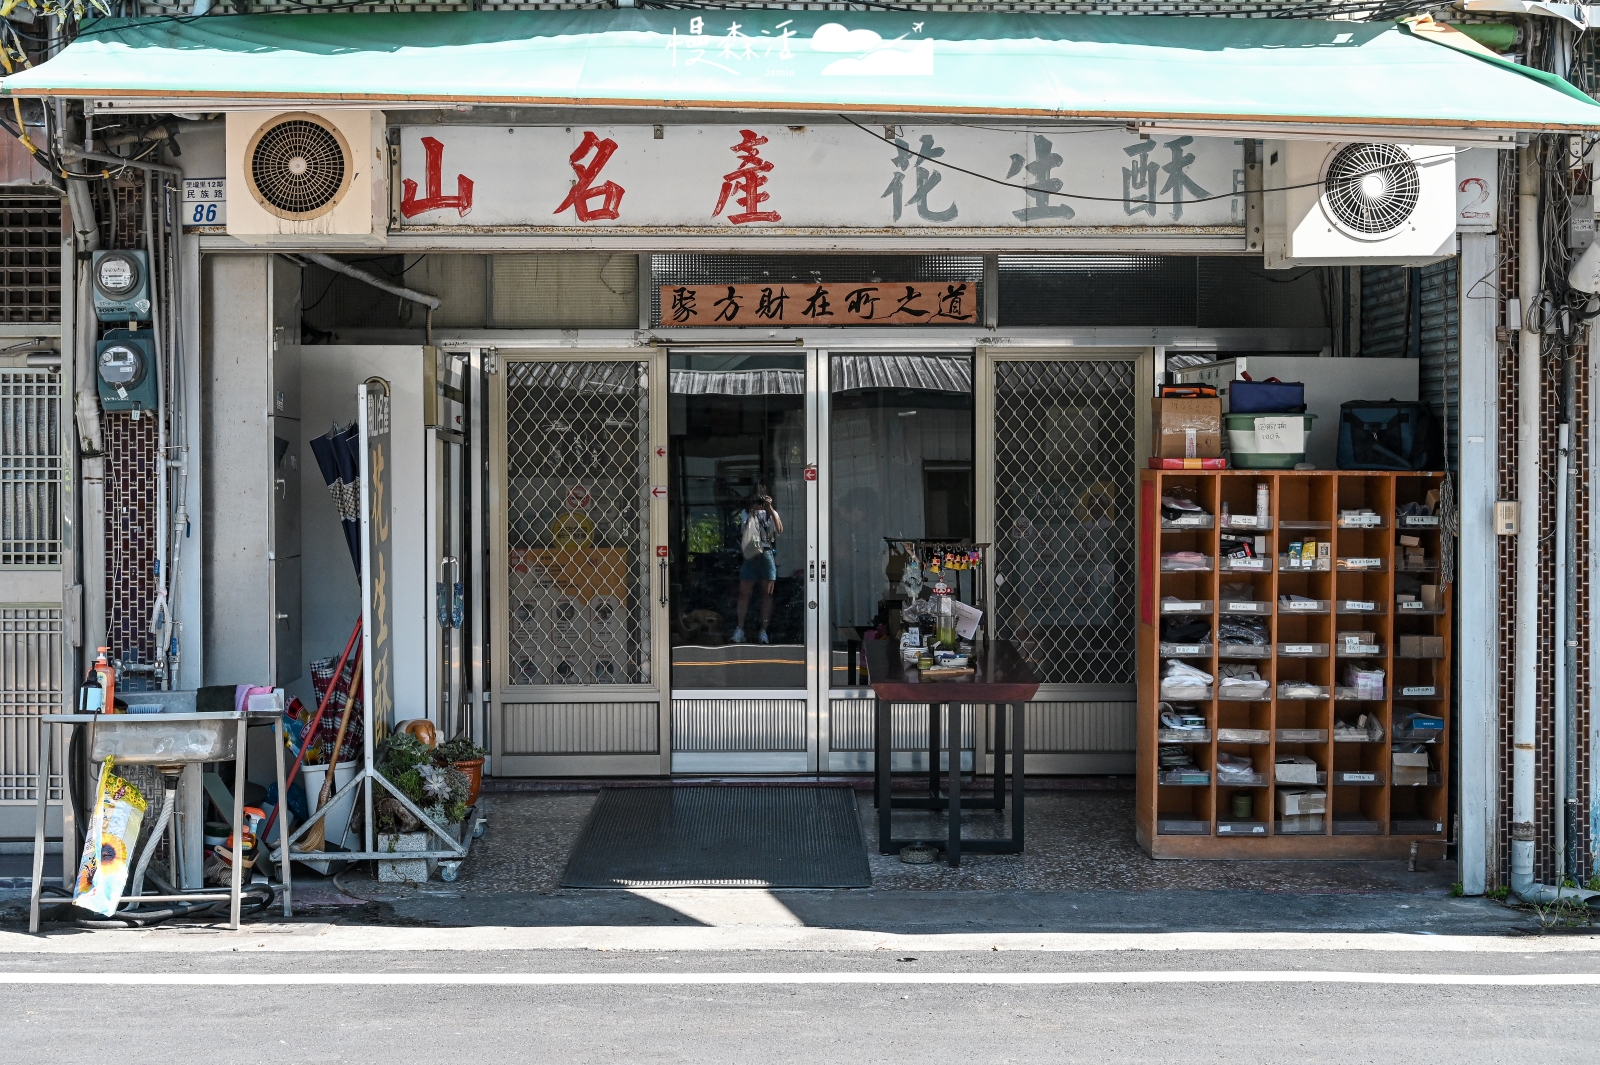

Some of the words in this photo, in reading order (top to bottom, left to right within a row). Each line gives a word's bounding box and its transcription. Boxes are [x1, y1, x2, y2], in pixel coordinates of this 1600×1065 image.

[187, 189, 223, 199] 民族路
[882, 133, 1246, 225] 花生酥
[192, 204, 217, 223] 86
[371, 443, 393, 750] 花生酥
